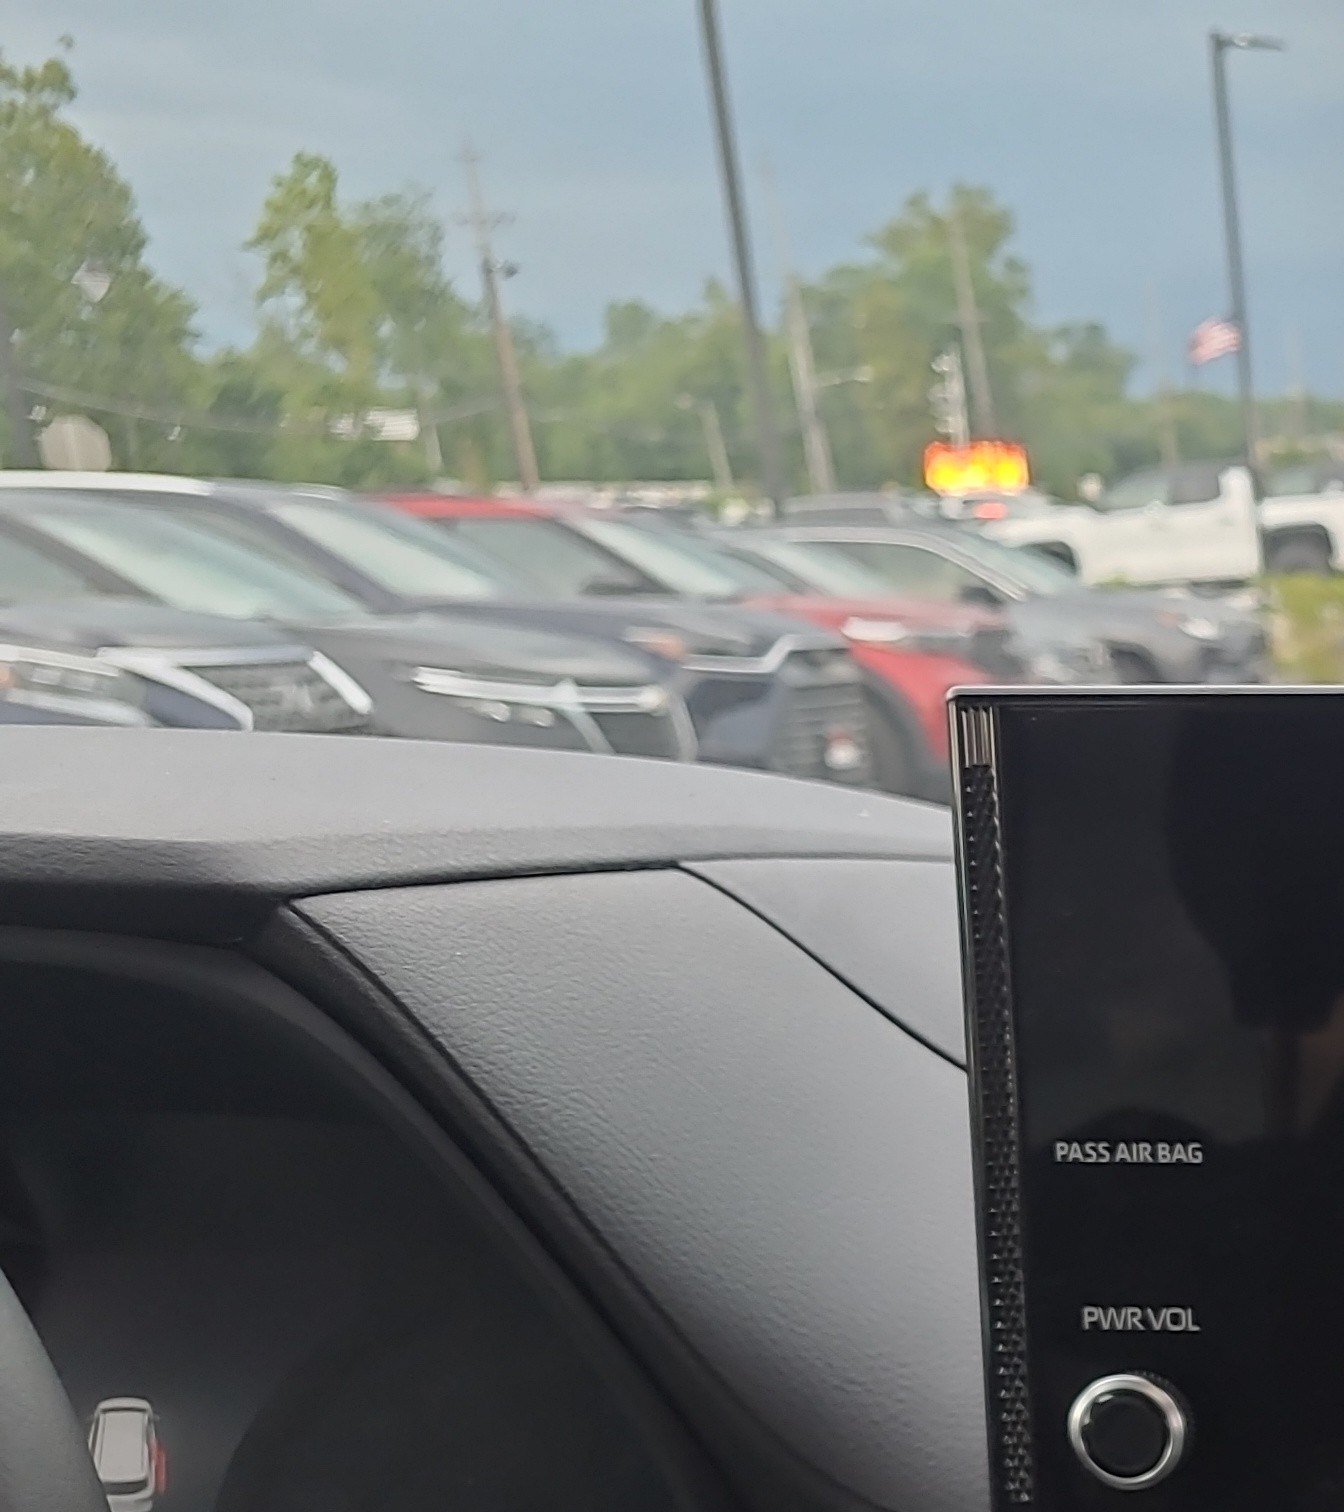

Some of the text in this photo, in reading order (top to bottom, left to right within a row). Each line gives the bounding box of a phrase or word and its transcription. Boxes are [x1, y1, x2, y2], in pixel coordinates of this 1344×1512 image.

[1055, 1141, 1203, 1163] PASS AIR BAG
[1083, 1305, 1200, 1331] PWR VOL
